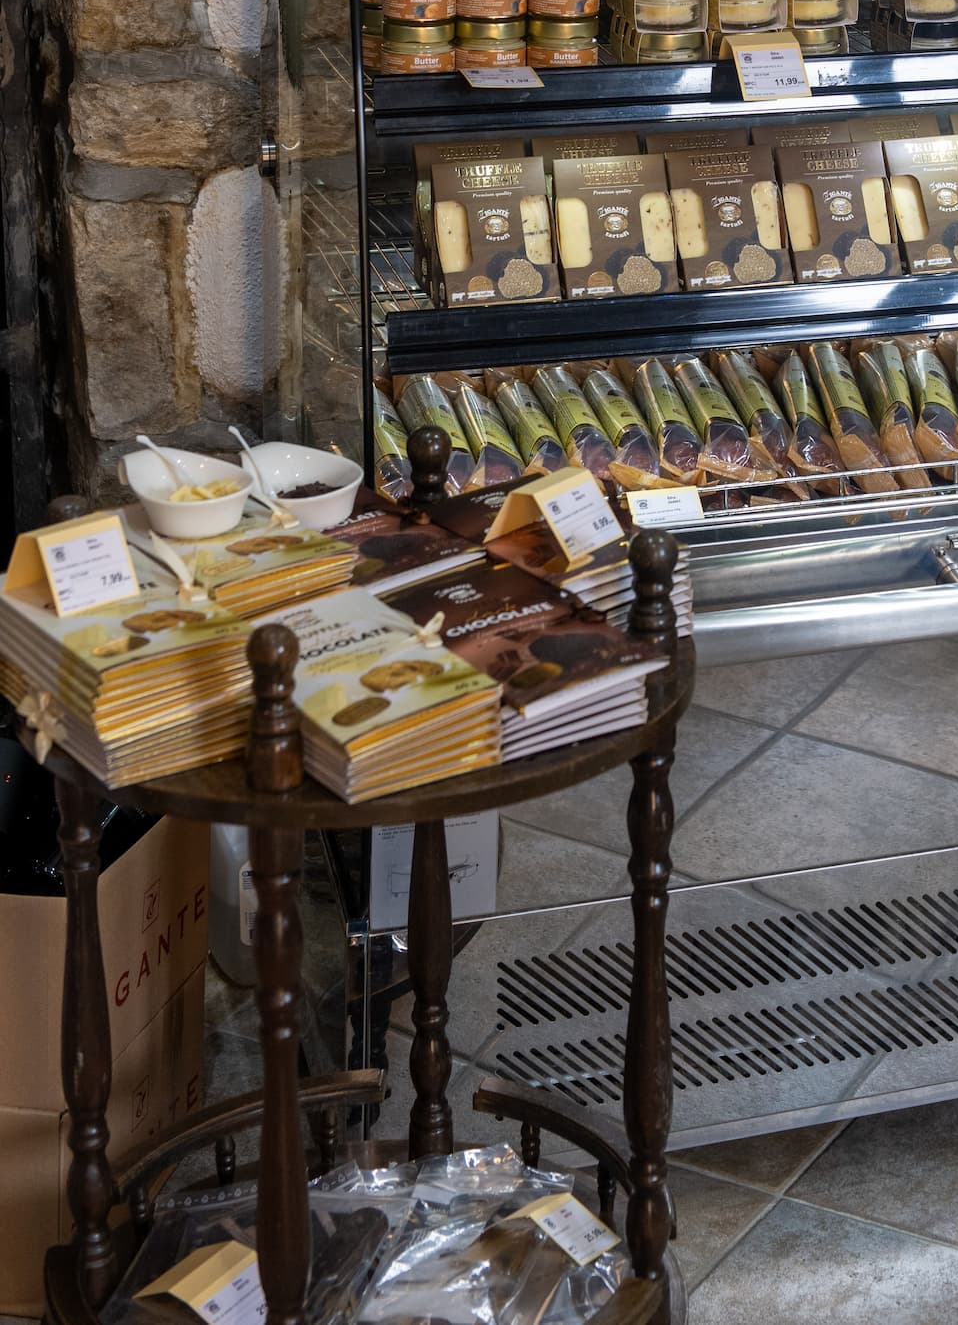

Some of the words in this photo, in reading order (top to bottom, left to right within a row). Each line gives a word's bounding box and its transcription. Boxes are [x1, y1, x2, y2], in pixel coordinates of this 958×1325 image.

[414, 57, 439, 65] Butter
[496, 52, 519, 61] Butter
[554, 52, 579, 60] Butter
[775, 77, 798, 87] 11,99
[455, 162, 523, 178] TRUFFLE
[806, 158, 860, 171] CHEESE
[461, 175, 521, 189] CHEESE
[583, 171, 640, 186] CHEESE
[615, 187, 633, 195] quality
[446, 601, 554, 638] CHOCOLATE
